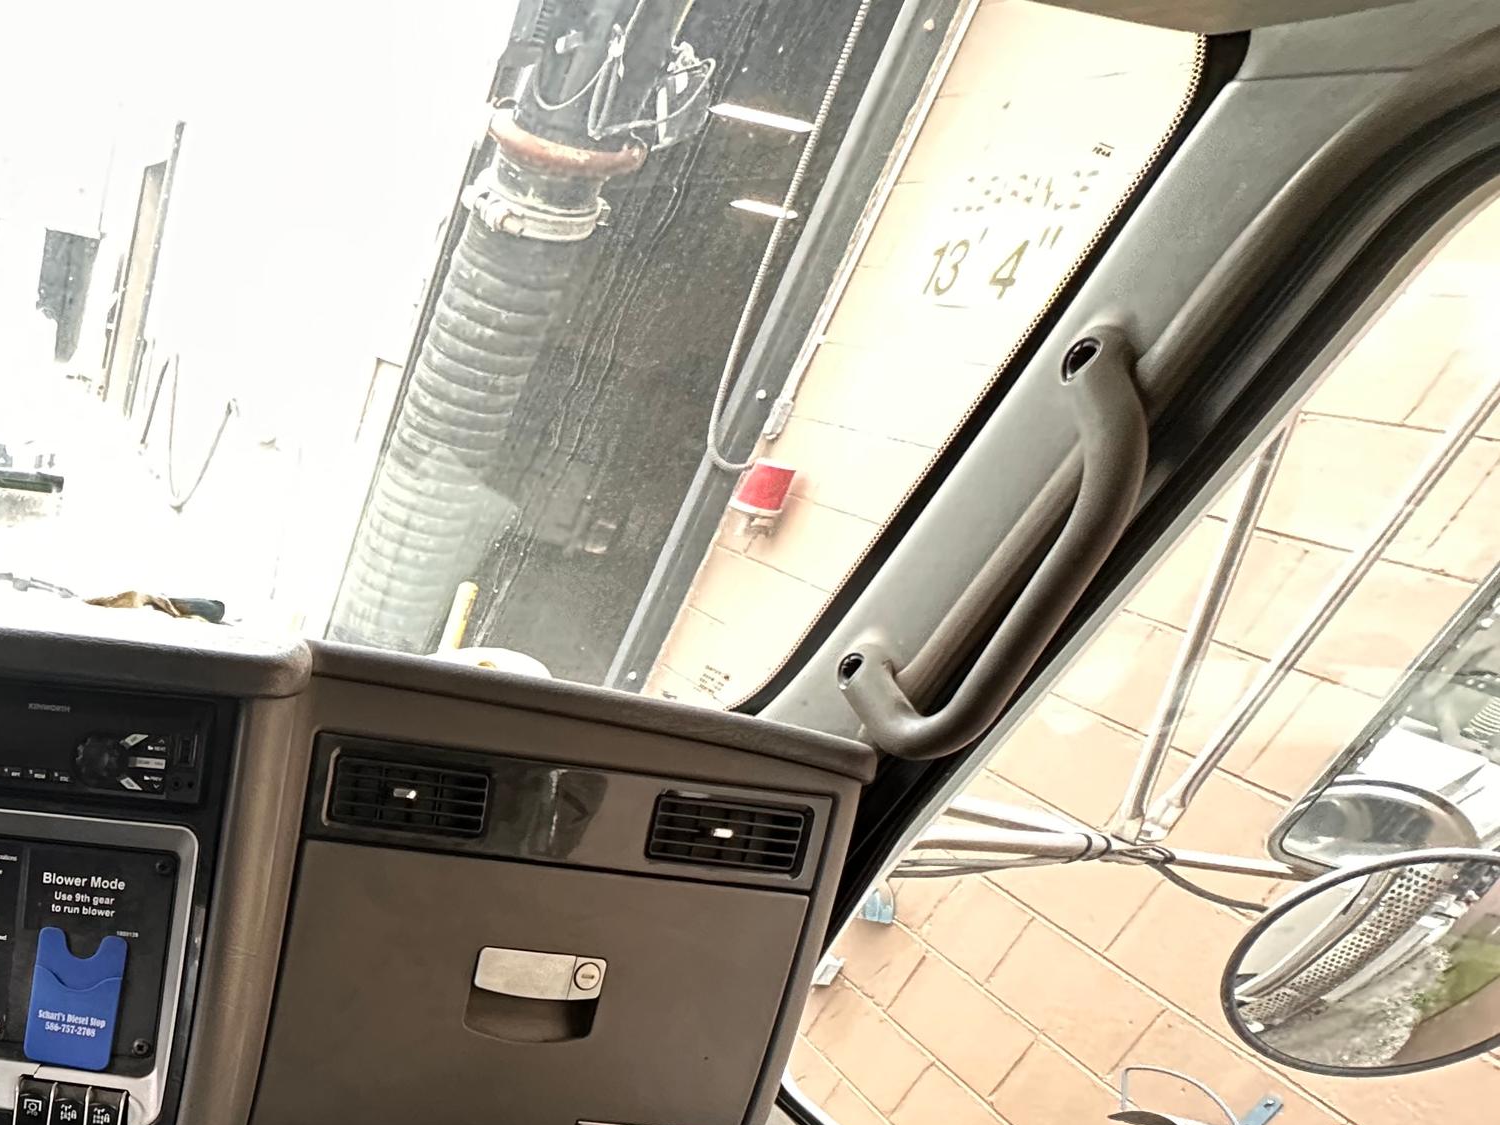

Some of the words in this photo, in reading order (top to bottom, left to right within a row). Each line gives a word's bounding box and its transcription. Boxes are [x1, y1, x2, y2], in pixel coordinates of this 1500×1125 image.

[43, 872, 87, 887] Blower
[91, 876, 126, 890] Mode
[54, 891, 73, 901] Use
[75, 893, 90, 902] 9th
[93, 896, 115, 906] gear
[51, 904, 61, 912] to
[63, 906, 80, 914] run
[82, 906, 116, 917] blower
[67, 1014, 89, 1025] Diesel
